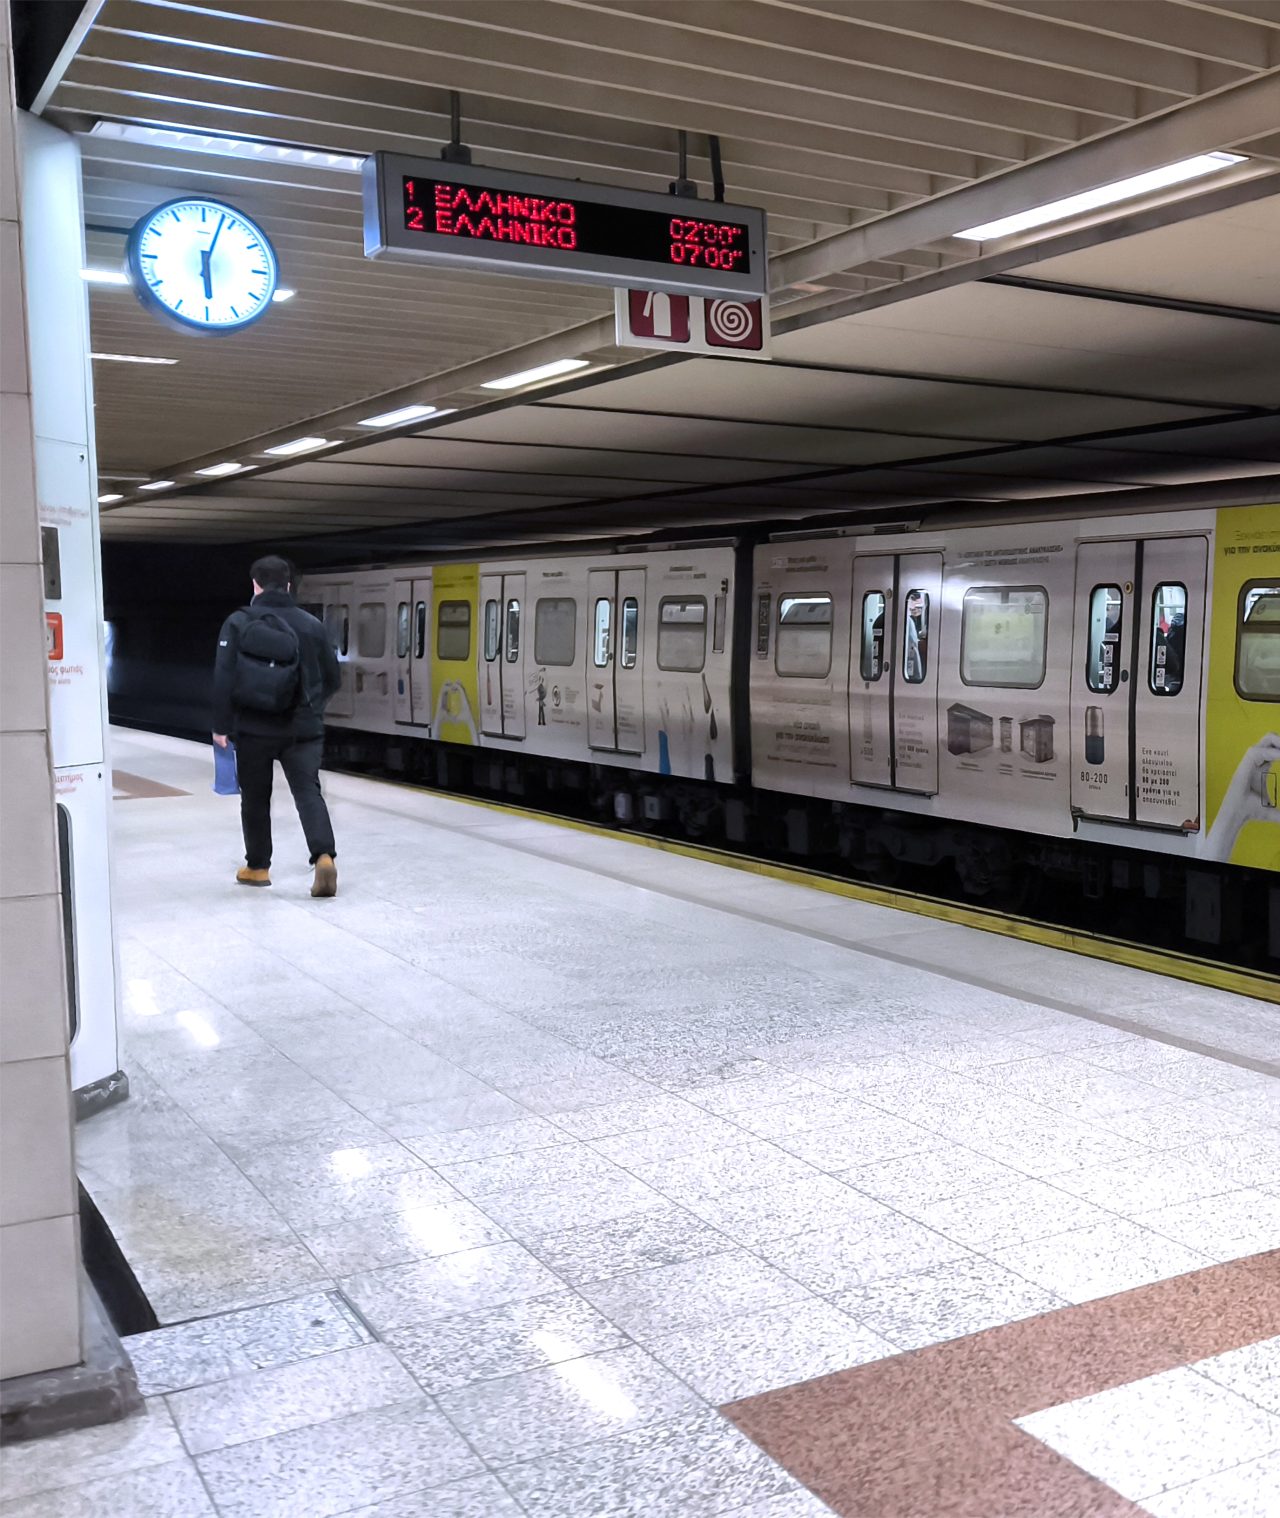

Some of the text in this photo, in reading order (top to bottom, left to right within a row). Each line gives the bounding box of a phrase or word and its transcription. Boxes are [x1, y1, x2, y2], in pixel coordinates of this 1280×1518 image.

[405, 181, 414, 201] 1
[435, 185, 575, 226] ΕΛΛΗΝΙΚΟ
[406, 207, 424, 229] 2
[436, 210, 578, 250] ΕΛΛΗΝΙΚΟ
[1081, 771, 1108, 784] 80-200
